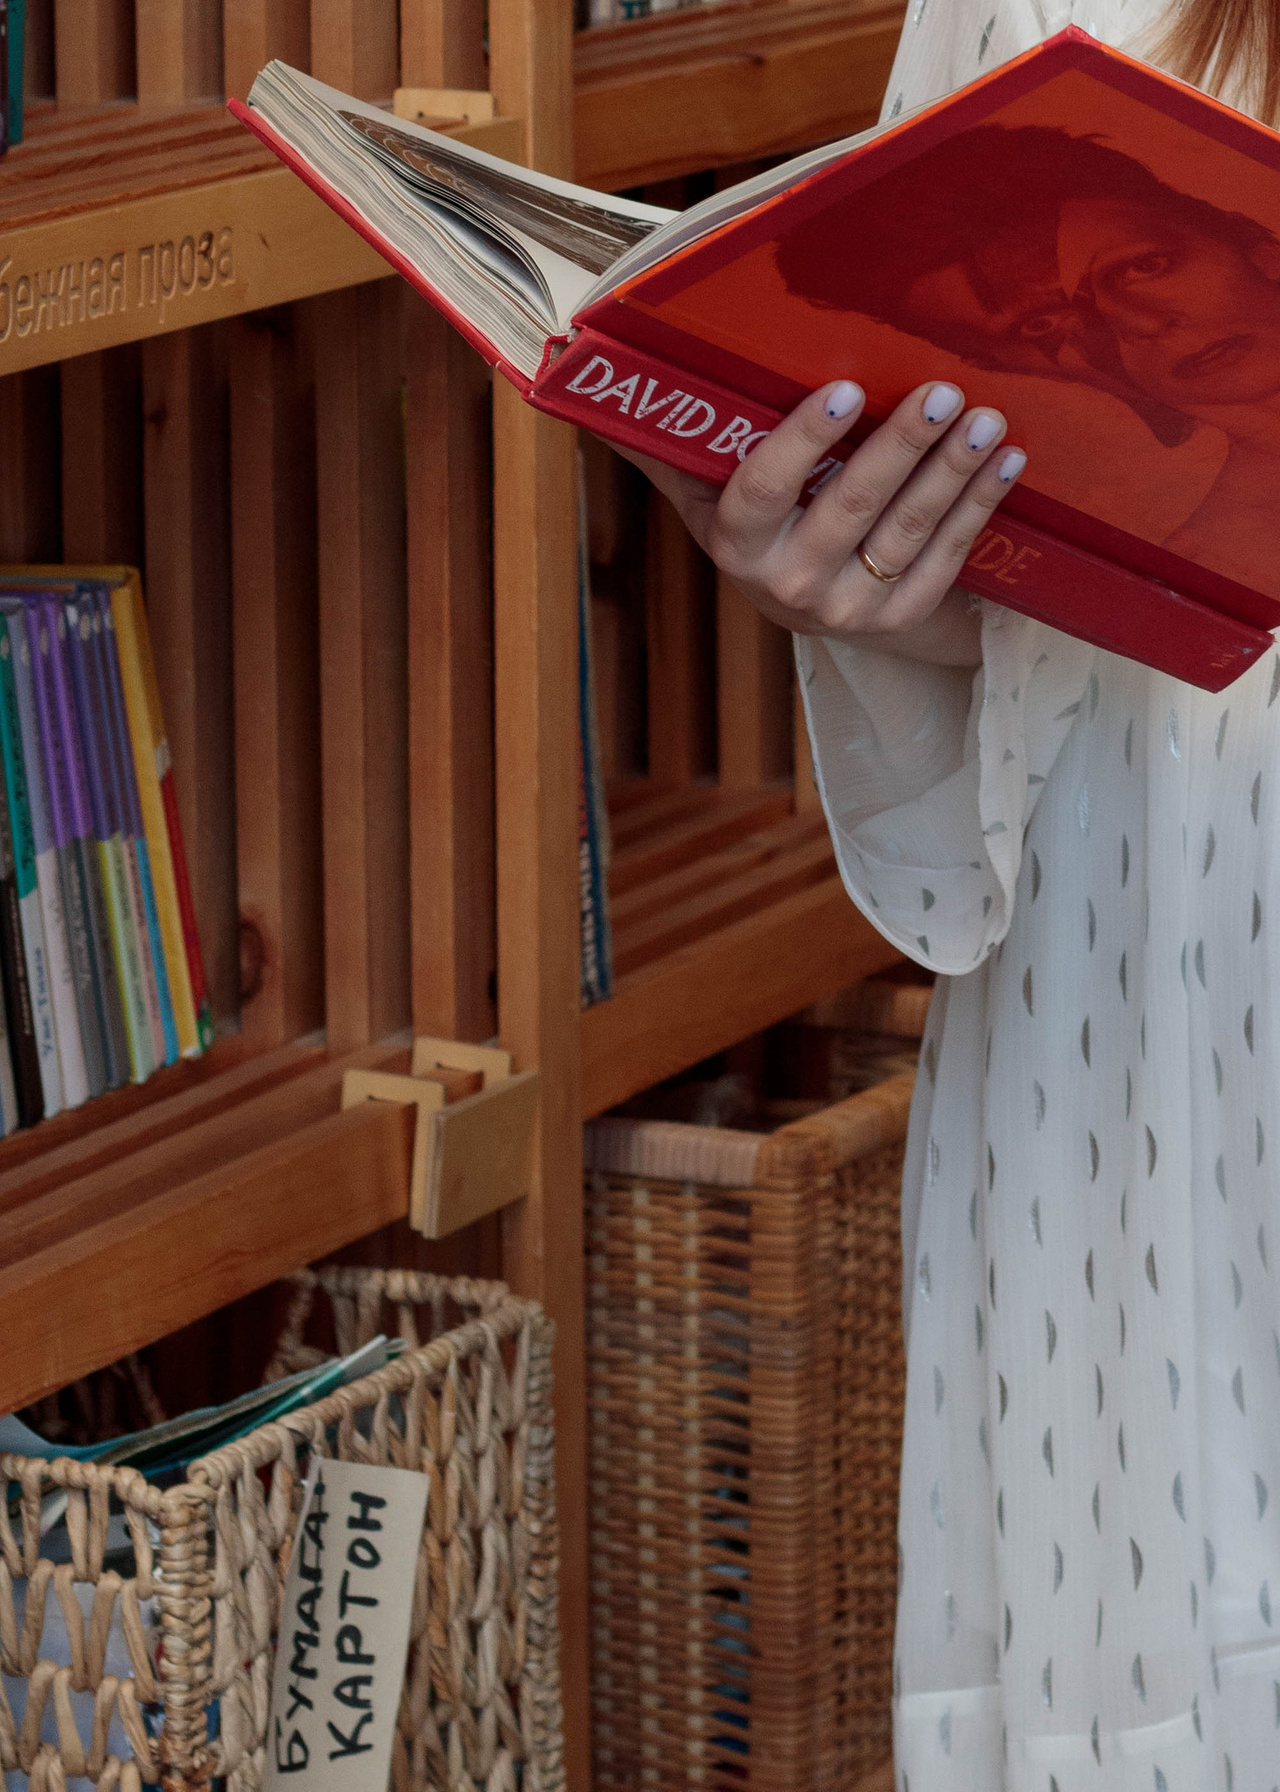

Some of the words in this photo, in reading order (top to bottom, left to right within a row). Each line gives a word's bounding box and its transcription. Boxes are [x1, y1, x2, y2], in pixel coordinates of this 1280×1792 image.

[138, 226, 235, 325] проза
[564, 355, 717, 438] DAVID
[275, 1508, 329, 1774] БУМАГА
[327, 1490, 388, 1762] КАРТОН
